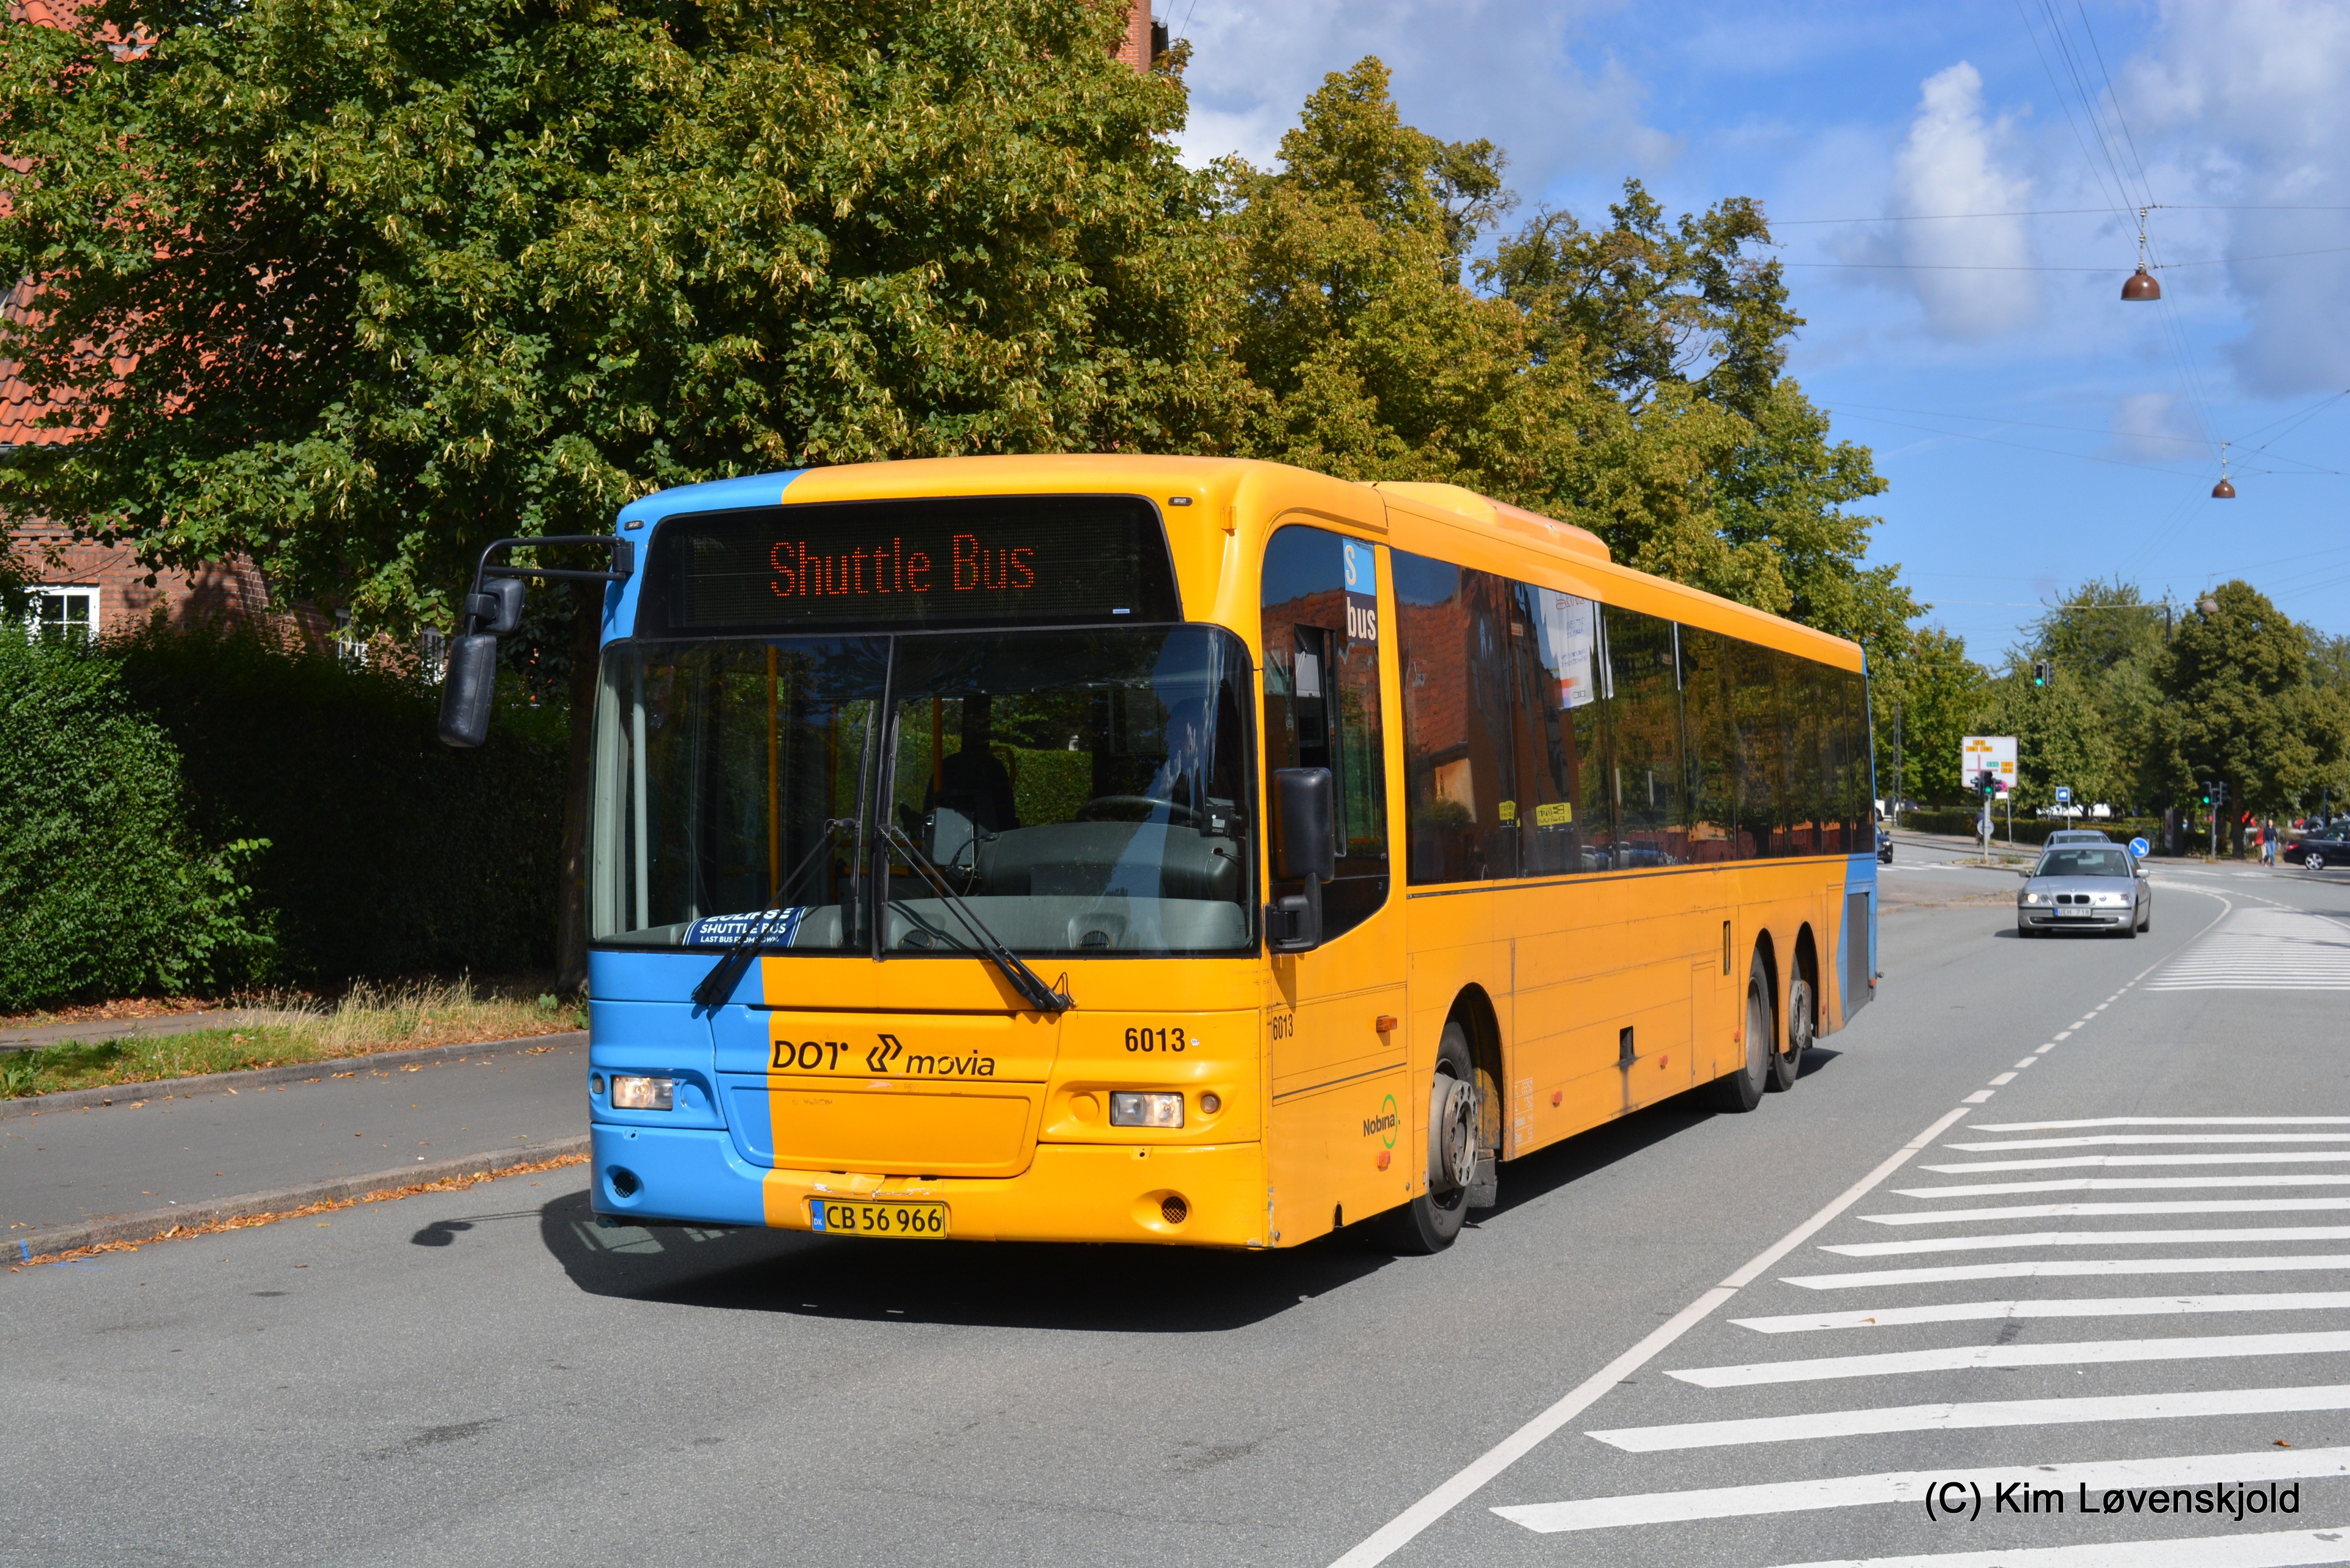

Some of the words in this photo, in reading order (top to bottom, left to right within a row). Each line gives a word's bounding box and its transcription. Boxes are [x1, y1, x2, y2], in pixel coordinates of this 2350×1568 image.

[771, 537, 931, 596] Shuttle
[953, 534, 1035, 590] Bus
[1345, 545, 1356, 586] S
[1346, 597, 1376, 641] bus
[699, 923, 759, 934] SHUTTLE
[761, 923, 786, 934] BUS
[1125, 1028, 1185, 1052] 6013
[1273, 1014, 1294, 1040] 6013
[772, 1040, 848, 1070] DOT
[906, 1050, 995, 1076] movia
[1363, 1113, 1395, 1137] Nobina
[826, 1206, 856, 1230] CB
[863, 1208, 890, 1231] 56
[897, 1208, 942, 1232] 966
